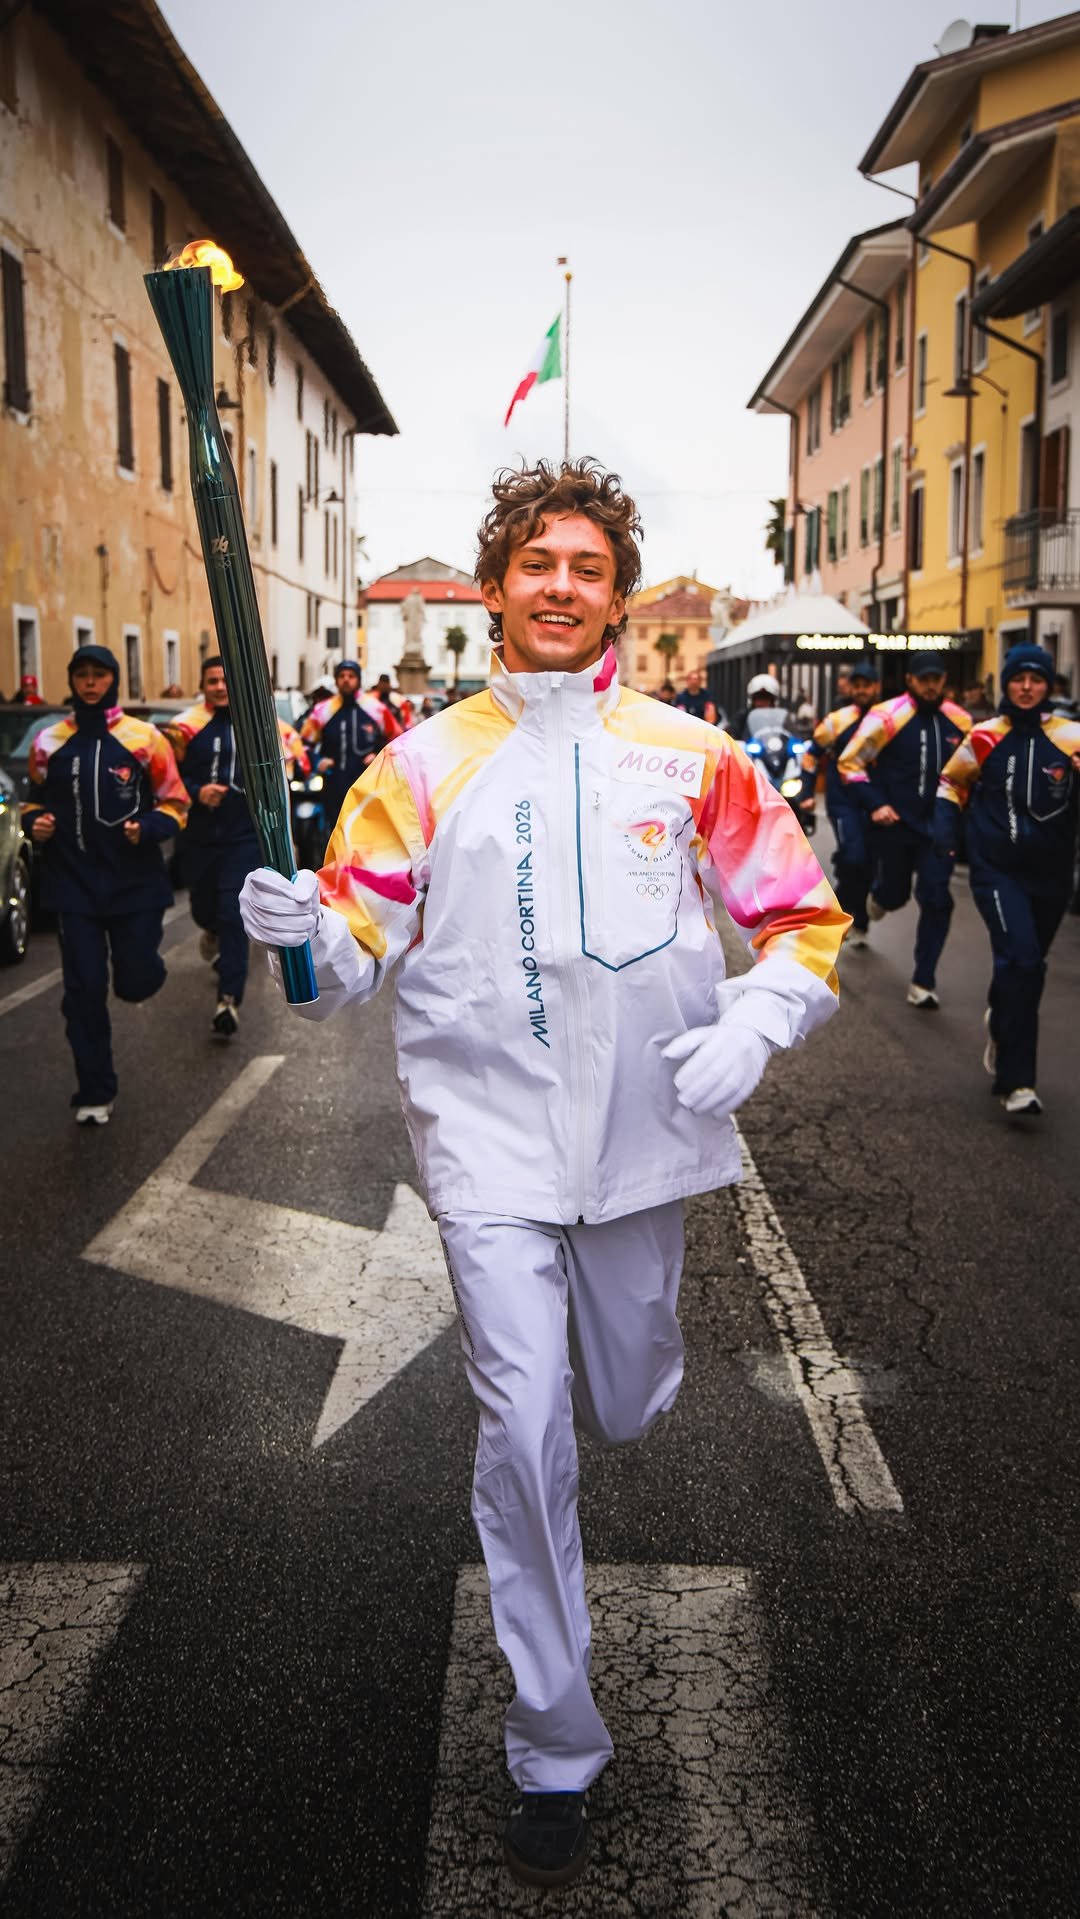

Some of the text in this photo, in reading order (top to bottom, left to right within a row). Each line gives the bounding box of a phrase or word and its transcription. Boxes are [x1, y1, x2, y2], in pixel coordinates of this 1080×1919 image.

[515, 800, 551, 1048] MILANO CORTINA 2026
